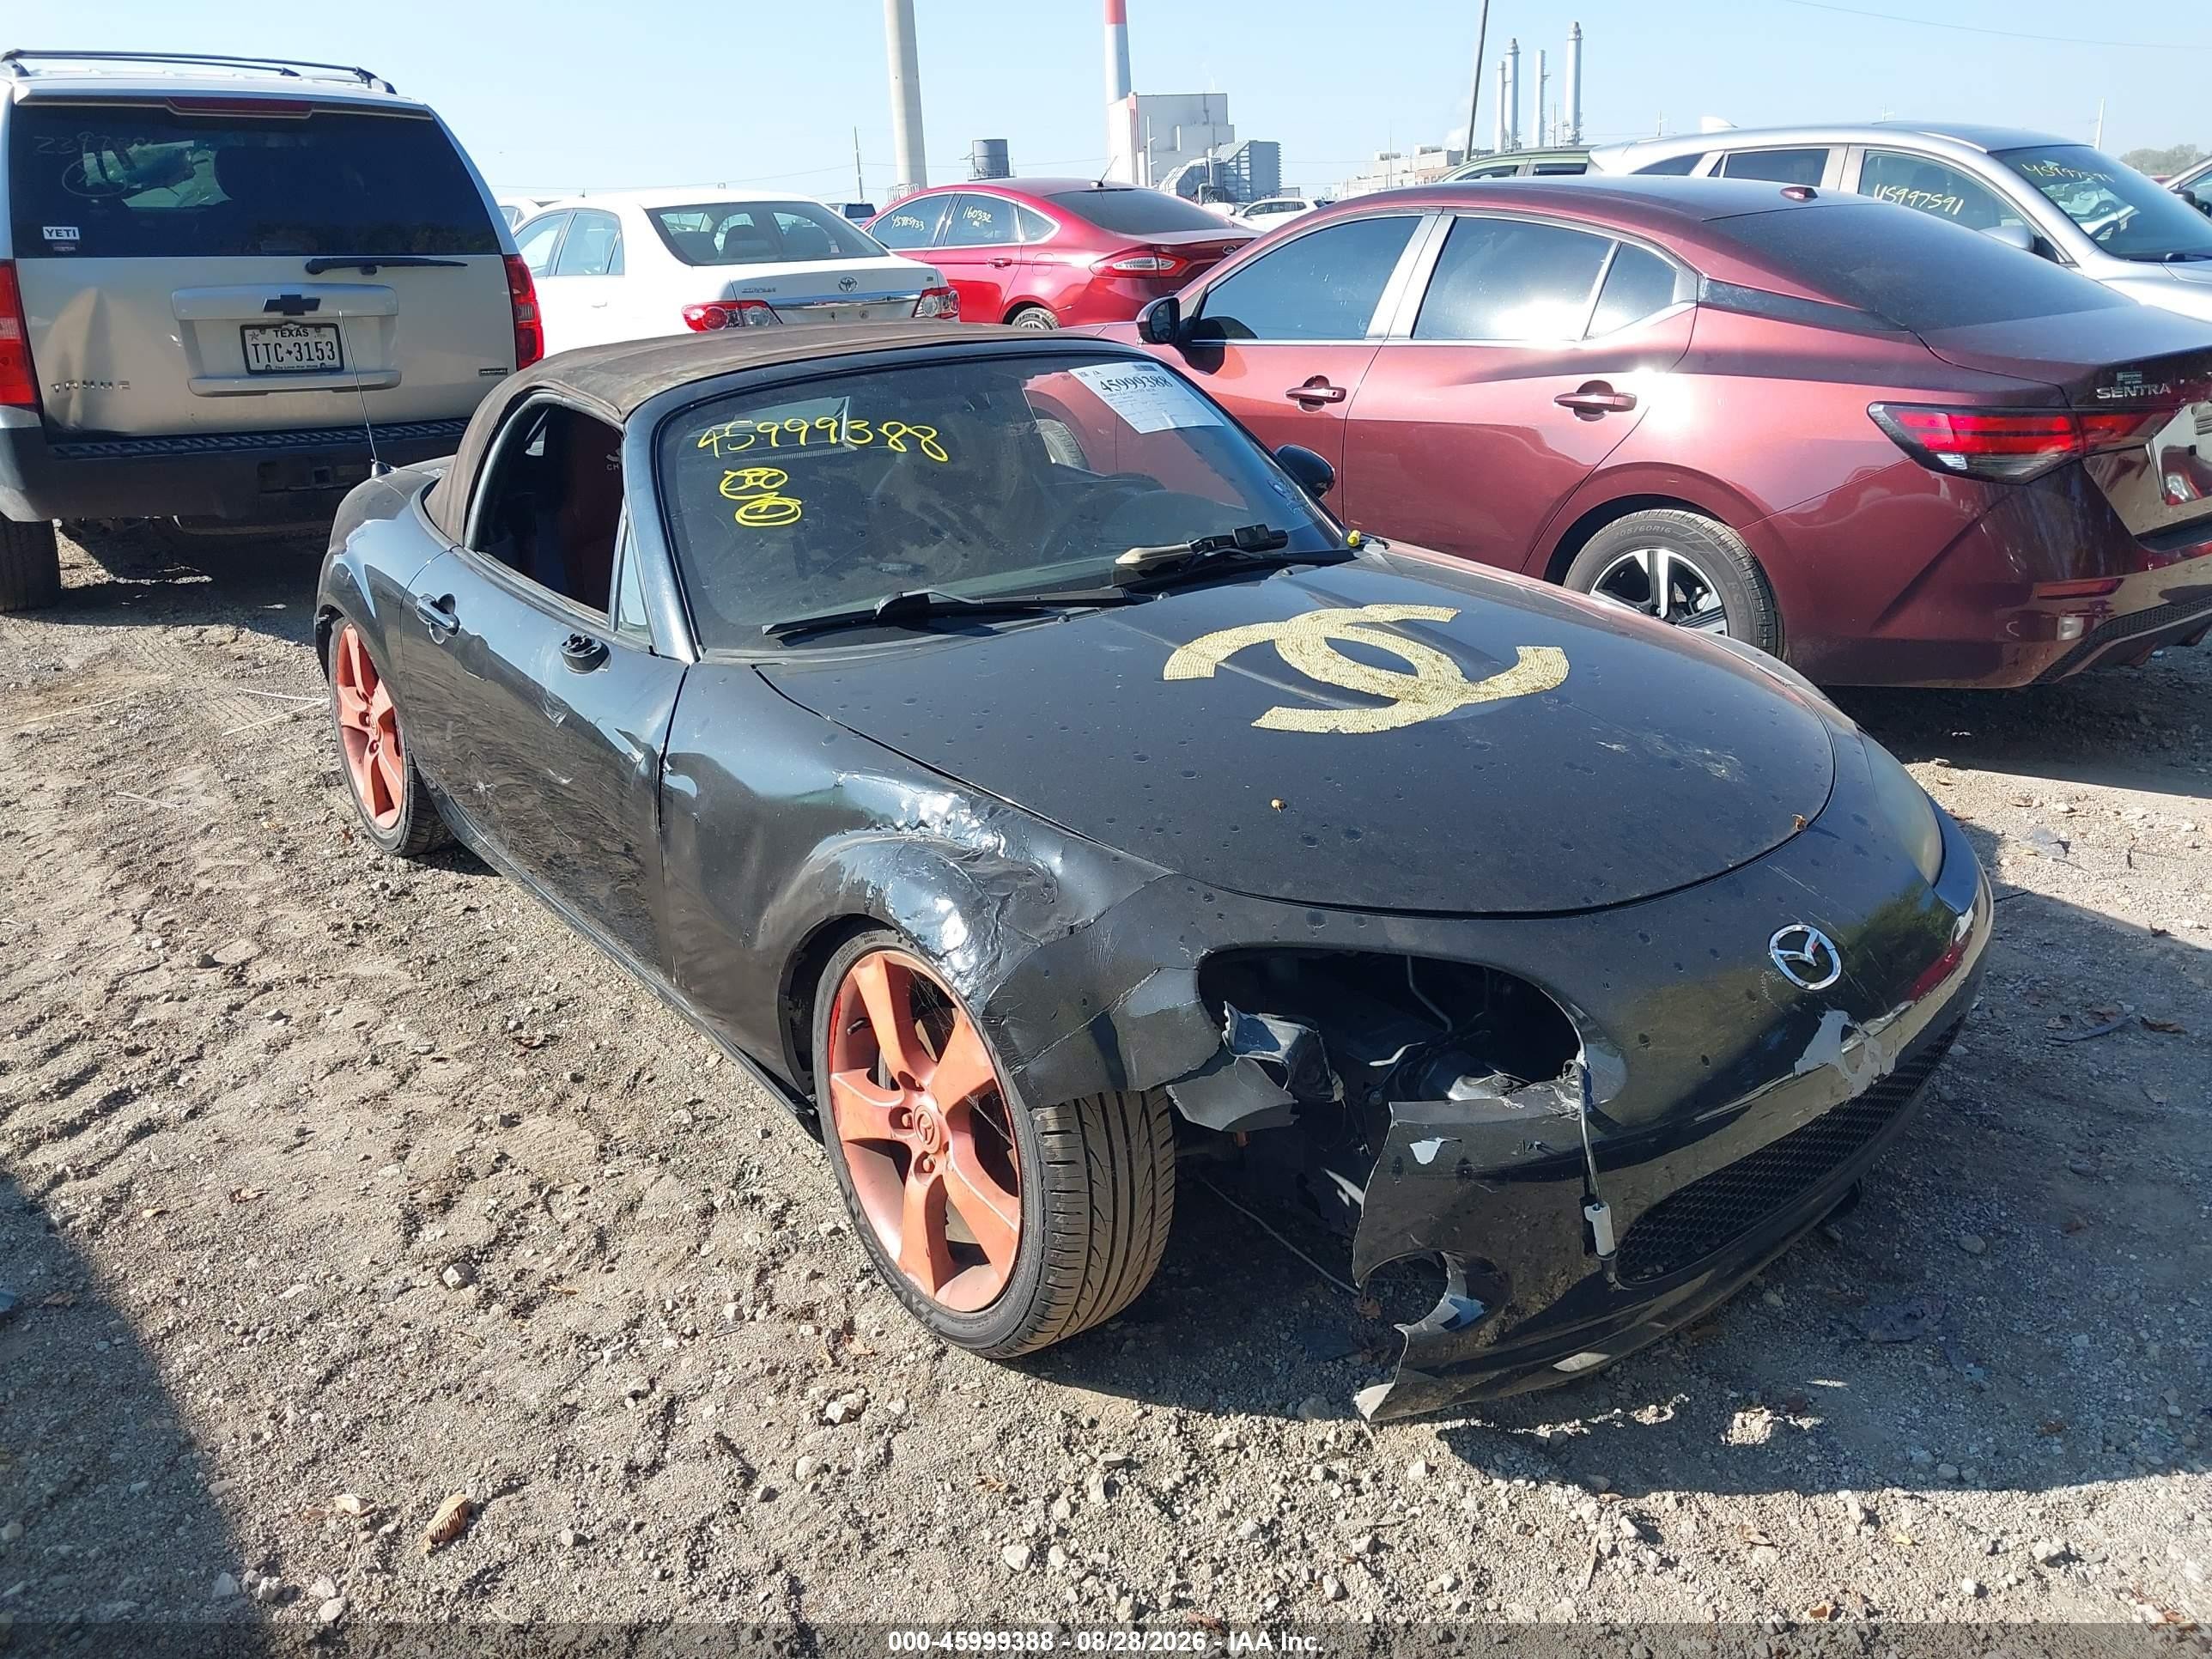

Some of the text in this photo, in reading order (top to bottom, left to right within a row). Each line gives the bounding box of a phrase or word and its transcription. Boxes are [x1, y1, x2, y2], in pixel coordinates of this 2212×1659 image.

[962, 206, 992, 222] 160332
[45, 228, 76, 238] YETI
[273, 328, 309, 337] TEXAS
[1100, 375, 1174, 392] 45999388
[2096, 383, 2172, 399] SENTRA
[697, 416, 949, 462] 45999388
